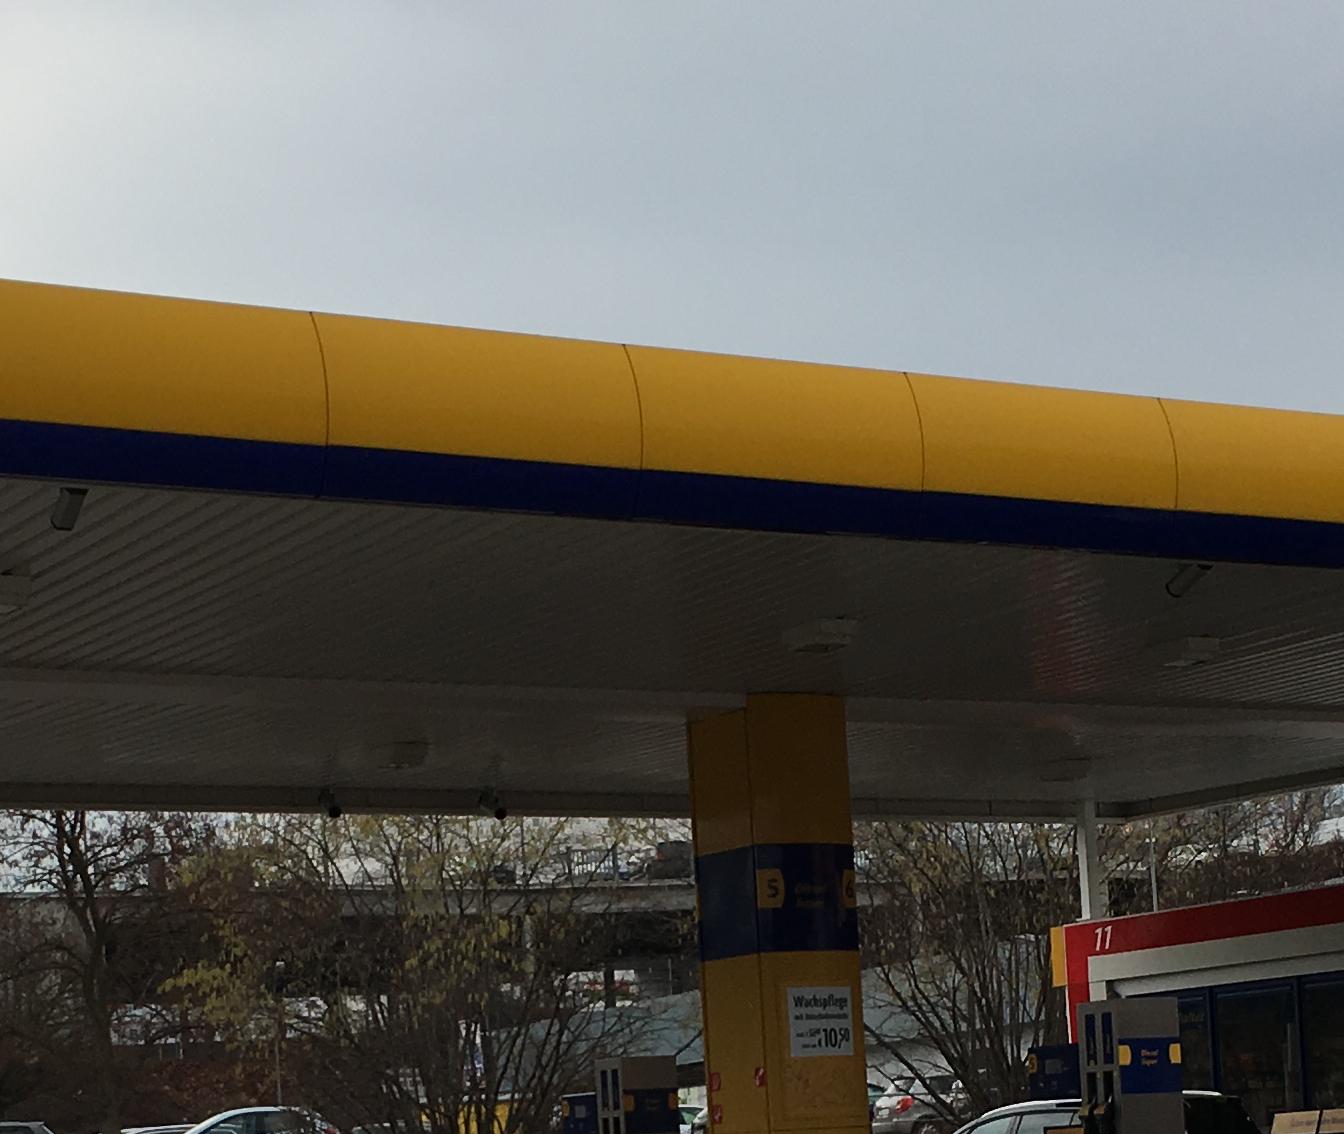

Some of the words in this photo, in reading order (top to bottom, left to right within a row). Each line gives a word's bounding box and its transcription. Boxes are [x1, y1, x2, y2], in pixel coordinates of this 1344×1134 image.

[766, 878, 779, 899] 5
[845, 878, 855, 899] 6
[1094, 925, 1112, 951] 11
